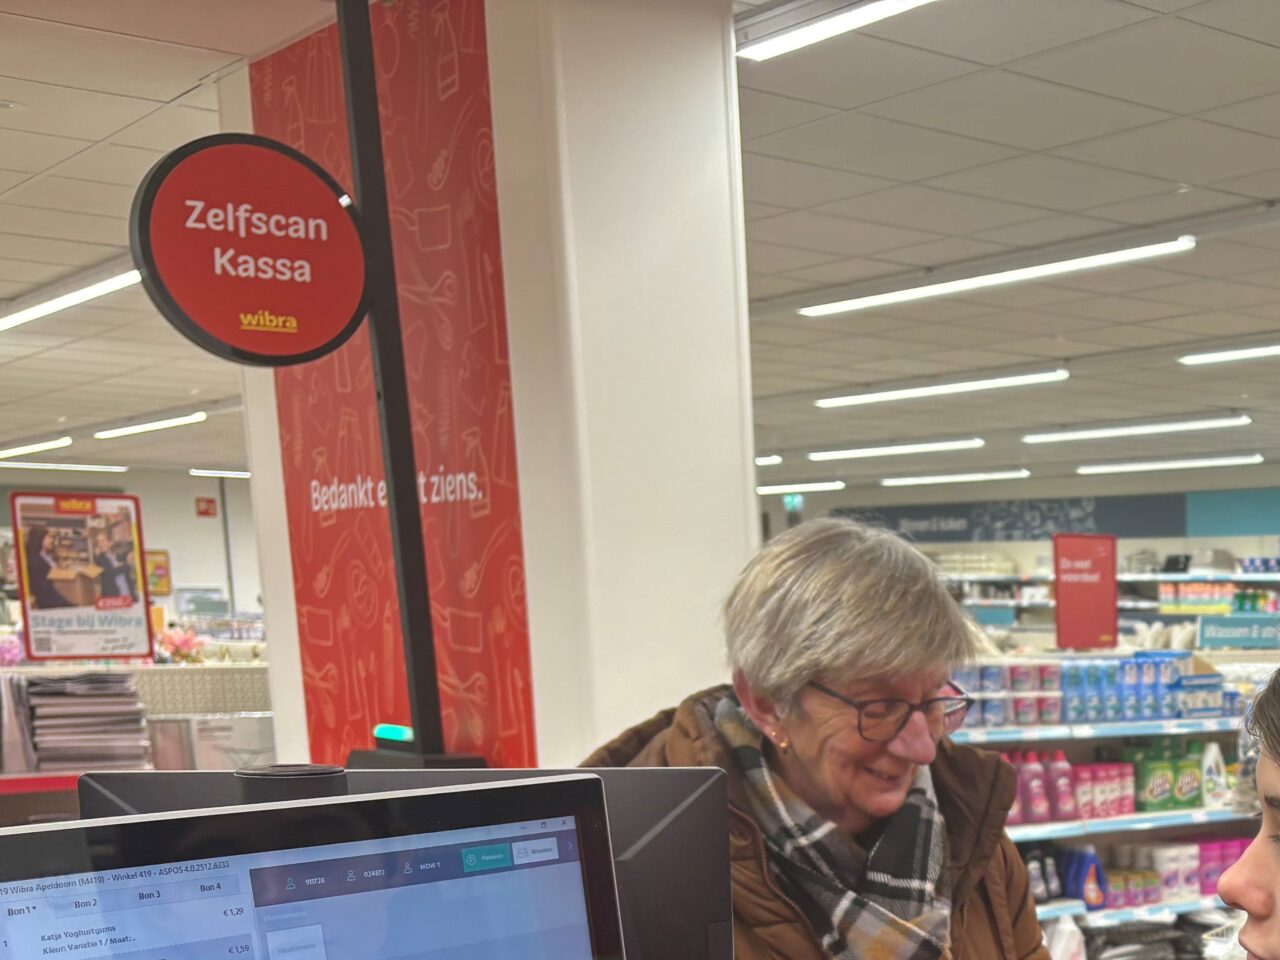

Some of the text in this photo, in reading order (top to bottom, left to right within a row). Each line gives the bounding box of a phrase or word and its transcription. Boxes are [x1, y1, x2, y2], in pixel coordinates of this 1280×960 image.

[184, 200, 328, 241] Zelfscan
[213, 247, 311, 283] Kassa
[239, 311, 298, 332] wibra
[310, 474, 375, 512] Bedankt
[377, 480, 388, 507] e
[430, 464, 484, 505] ziens.
[31, 615, 143, 630] Stage bij Wibra
[1204, 624, 1249, 639] Wassen
[10, 886, 34, 894] Wibra
[35, 880, 77, 892] Apeldoorn
[78, 876, 105, 887] (M419)
[111, 872, 138, 882] Winkel
[139, 870, 152, 878] 419
[158, 866, 183, 876] ASPOS
[200, 882, 222, 892] Bon 4
[138, 890, 161, 901] Bon 3
[74, 899, 98, 909] Bon 2
[7, 908, 26, 917] Bon
[40, 933, 62, 943] Katja
[63, 925, 117, 939] Yoghurtgums
[230, 907, 244, 917] 1,29
[42, 945, 66, 955] Kleur:
[236, 944, 250, 954] 1,59
